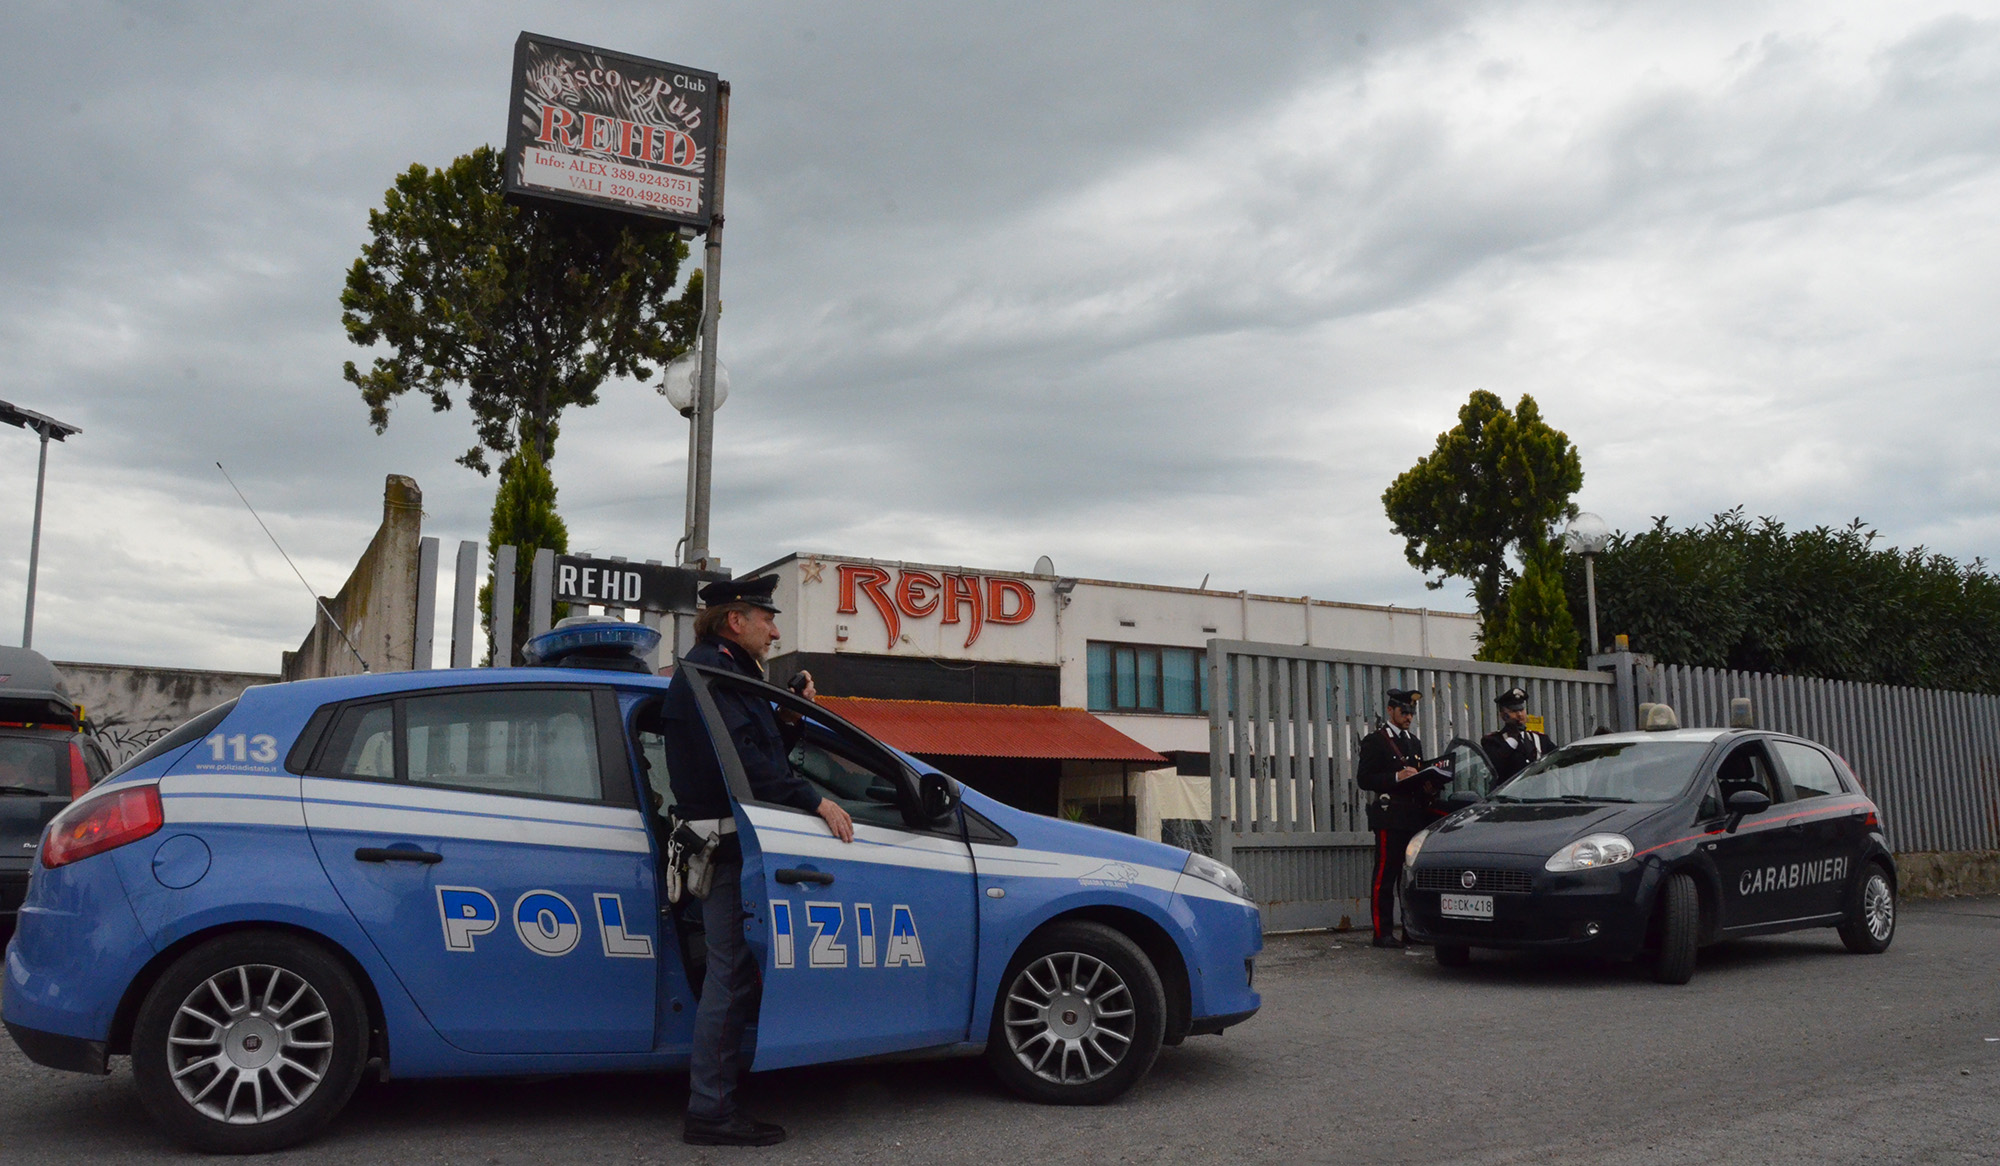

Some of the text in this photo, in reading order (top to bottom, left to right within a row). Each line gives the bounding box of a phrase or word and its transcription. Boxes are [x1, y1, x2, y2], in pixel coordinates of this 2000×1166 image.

[535, 63, 621, 99] Disco
[648, 77, 702, 129] Pub
[673, 74, 706, 93] Club
[534, 102, 698, 169] REHD
[535, 152, 692, 192] Info: ALEX 389.9243751
[569, 176, 693, 208] VALI 320.4928657
[558, 564, 642, 602] REHD
[836, 563, 1036, 649] REHD
[196, 763, 277, 773] www.poliziadistato.it
[206, 734, 278, 763] 113
[1739, 856, 1848, 896] CARABINIERI
